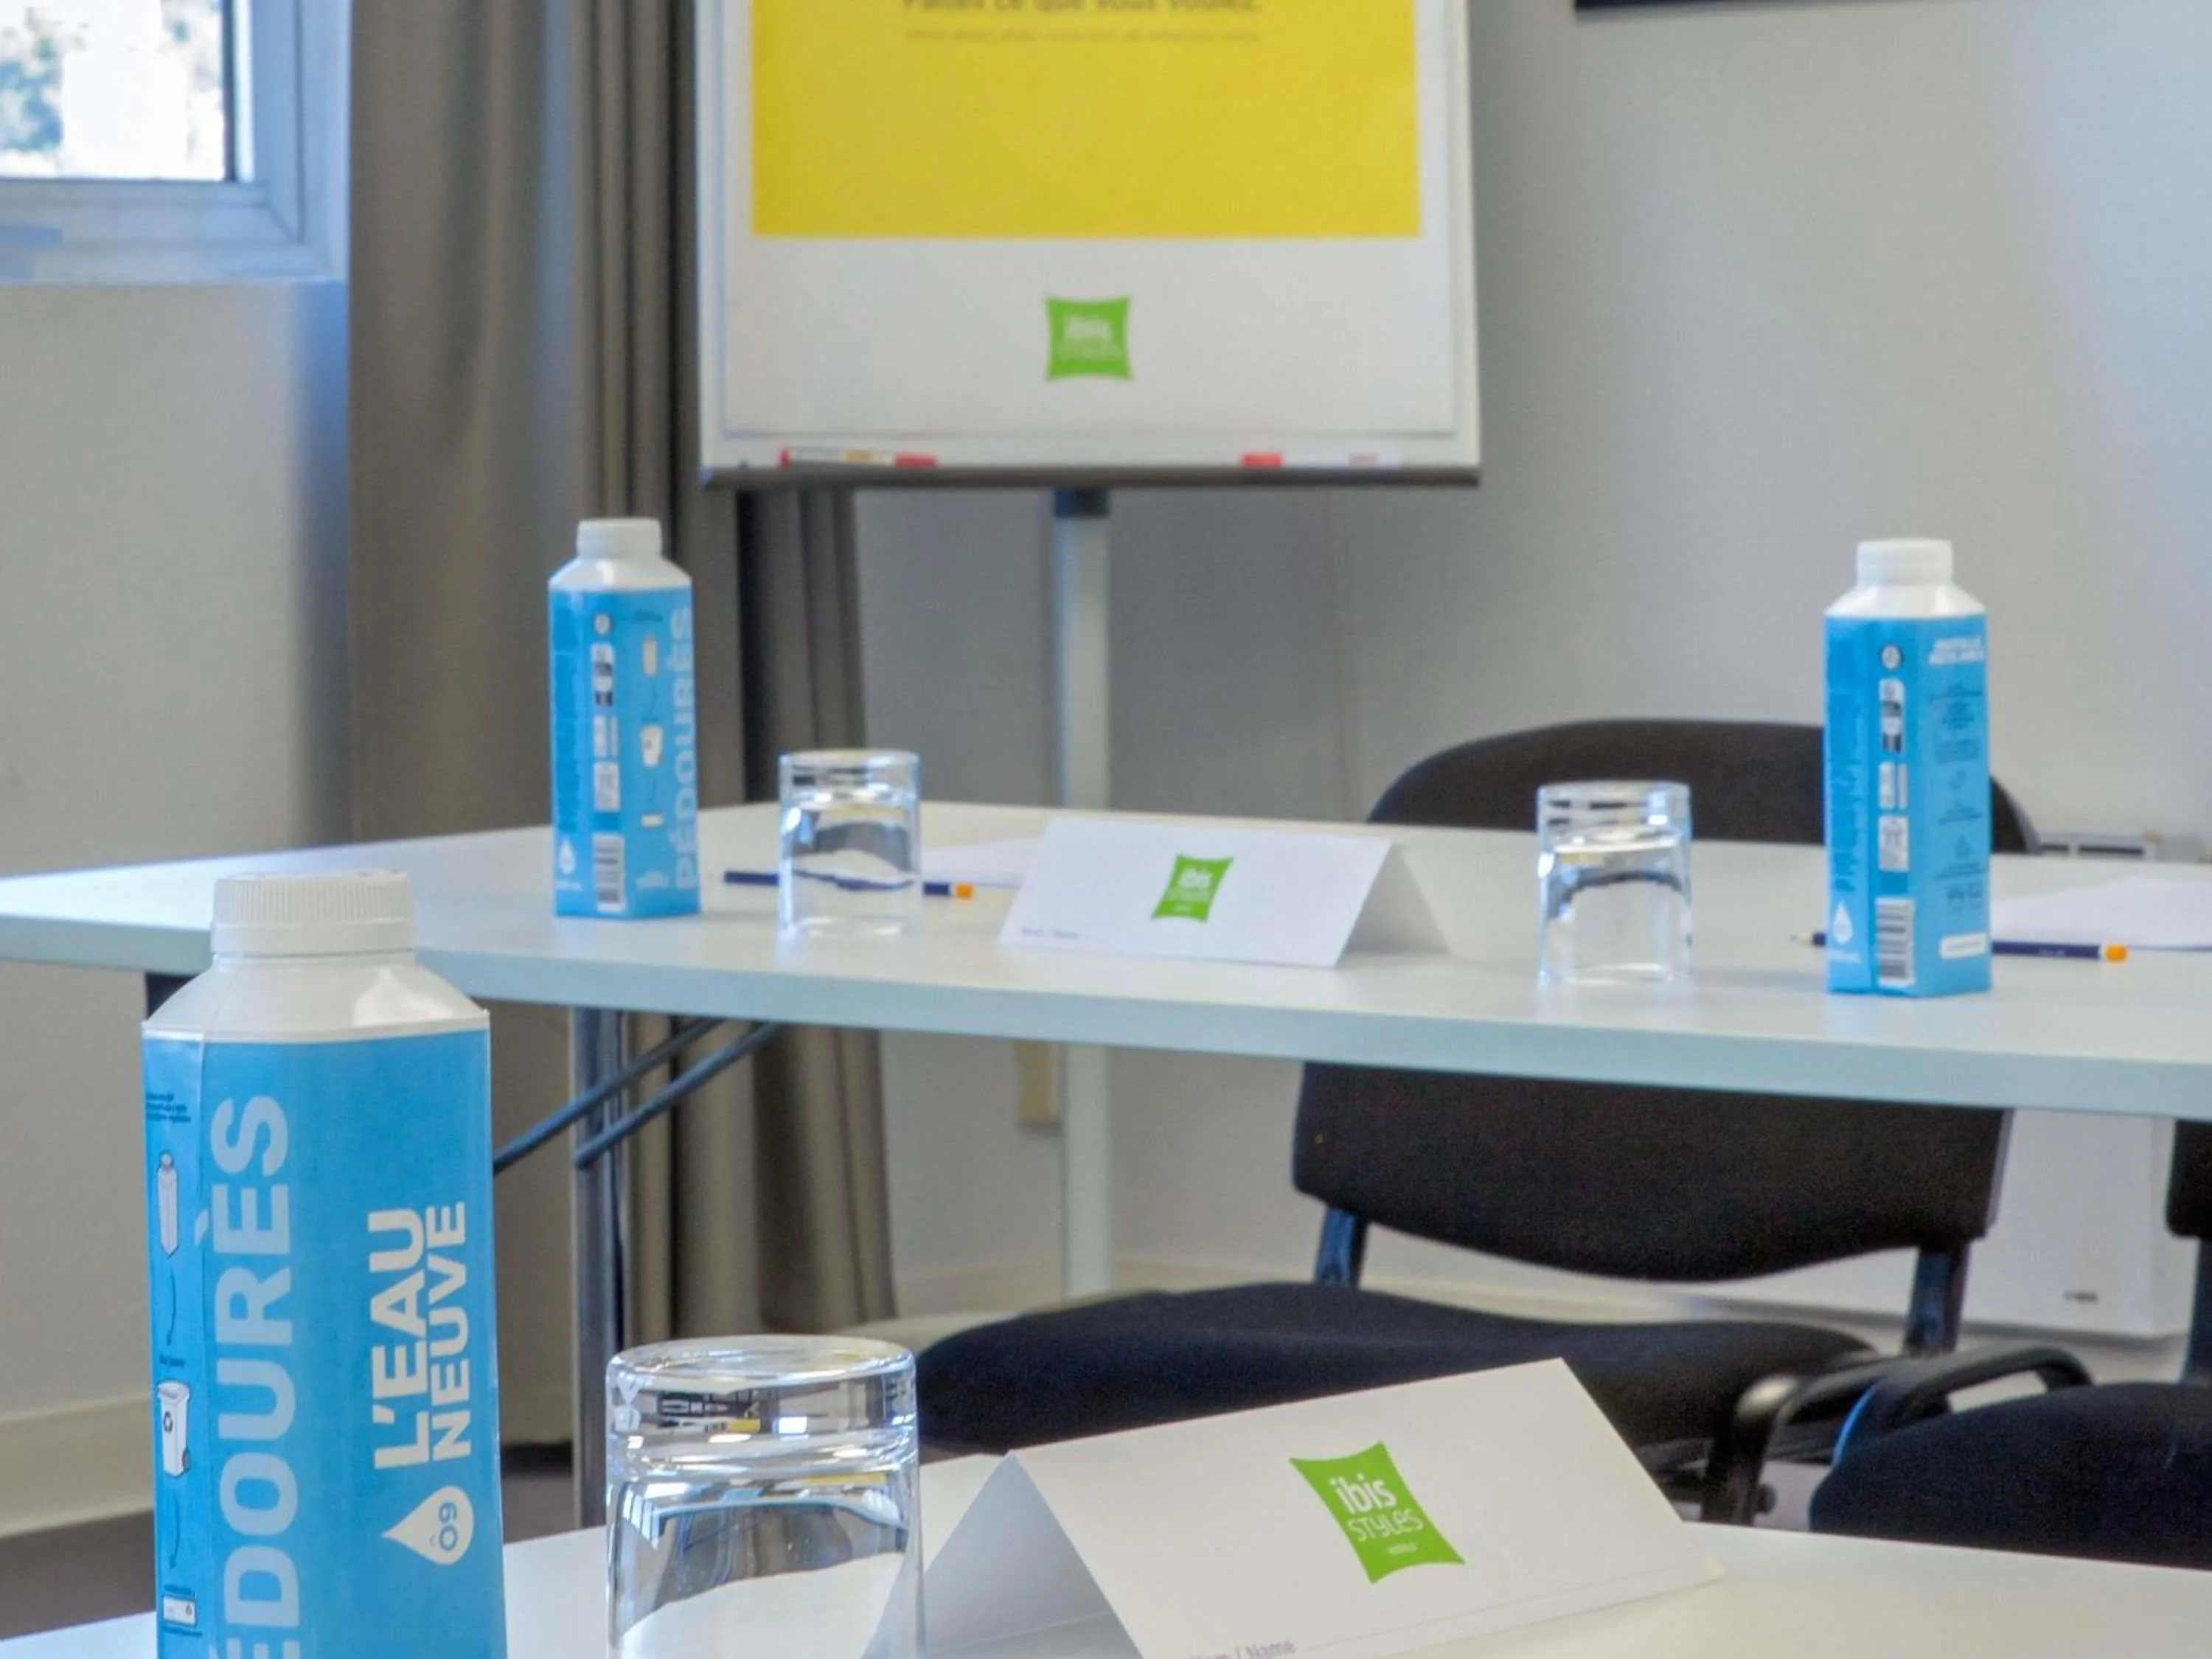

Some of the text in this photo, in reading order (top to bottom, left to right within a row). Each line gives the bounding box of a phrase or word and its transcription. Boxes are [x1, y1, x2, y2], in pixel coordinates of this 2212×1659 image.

[195, 1094, 301, 1659] DOURÈS
[368, 1208, 429, 1470] L'EAU
[426, 1202, 472, 1461] NEUVE
[1329, 1473, 1397, 1514] ibis
